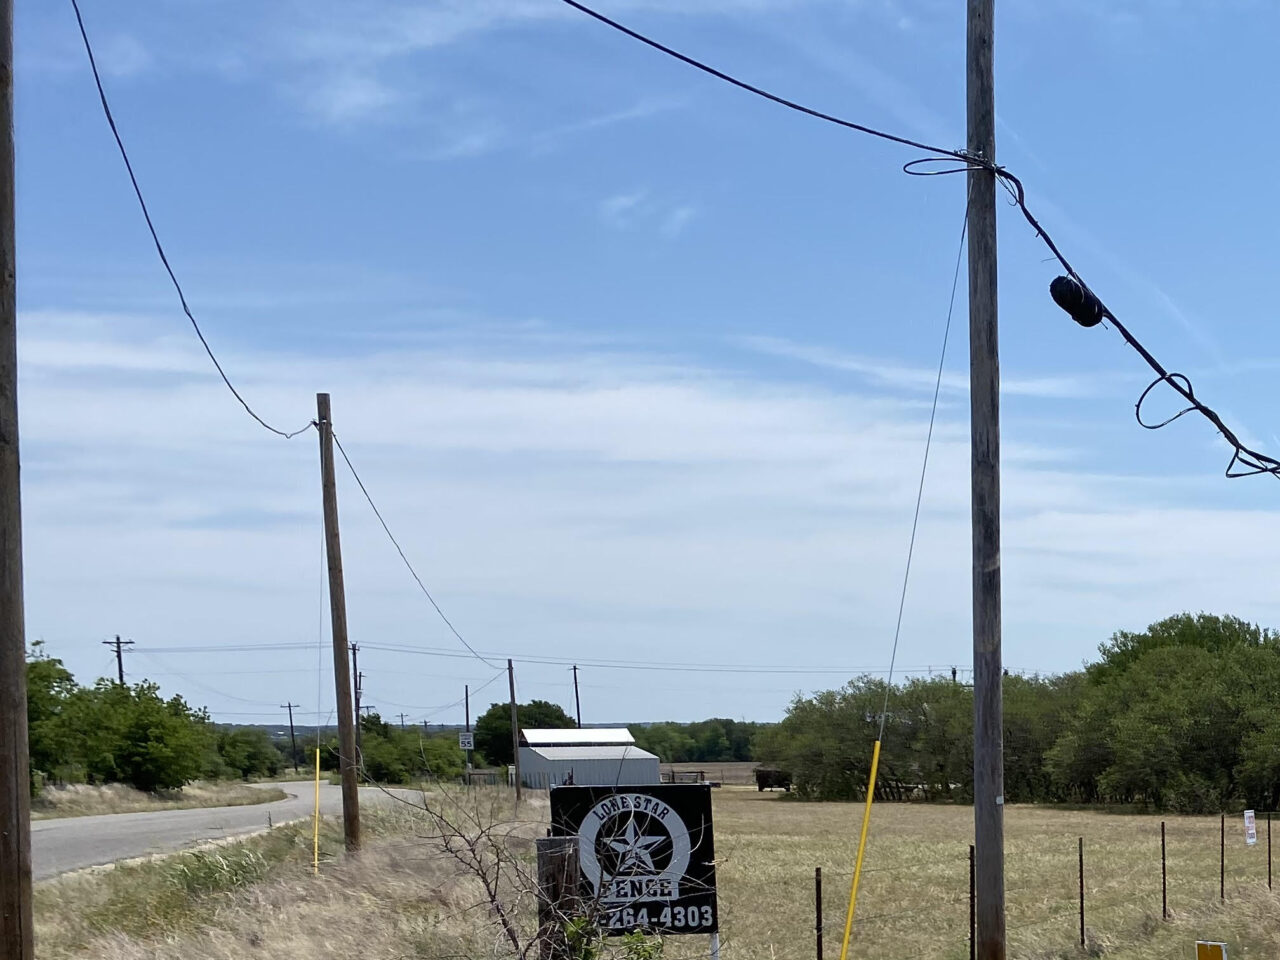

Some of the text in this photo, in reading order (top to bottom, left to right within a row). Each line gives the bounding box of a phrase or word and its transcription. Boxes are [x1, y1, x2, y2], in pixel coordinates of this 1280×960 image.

[460, 740, 472, 748] 55
[593, 796, 670, 820] LONE STAR
[600, 879, 673, 898] FENCE
[598, 905, 713, 928] -264-4303
